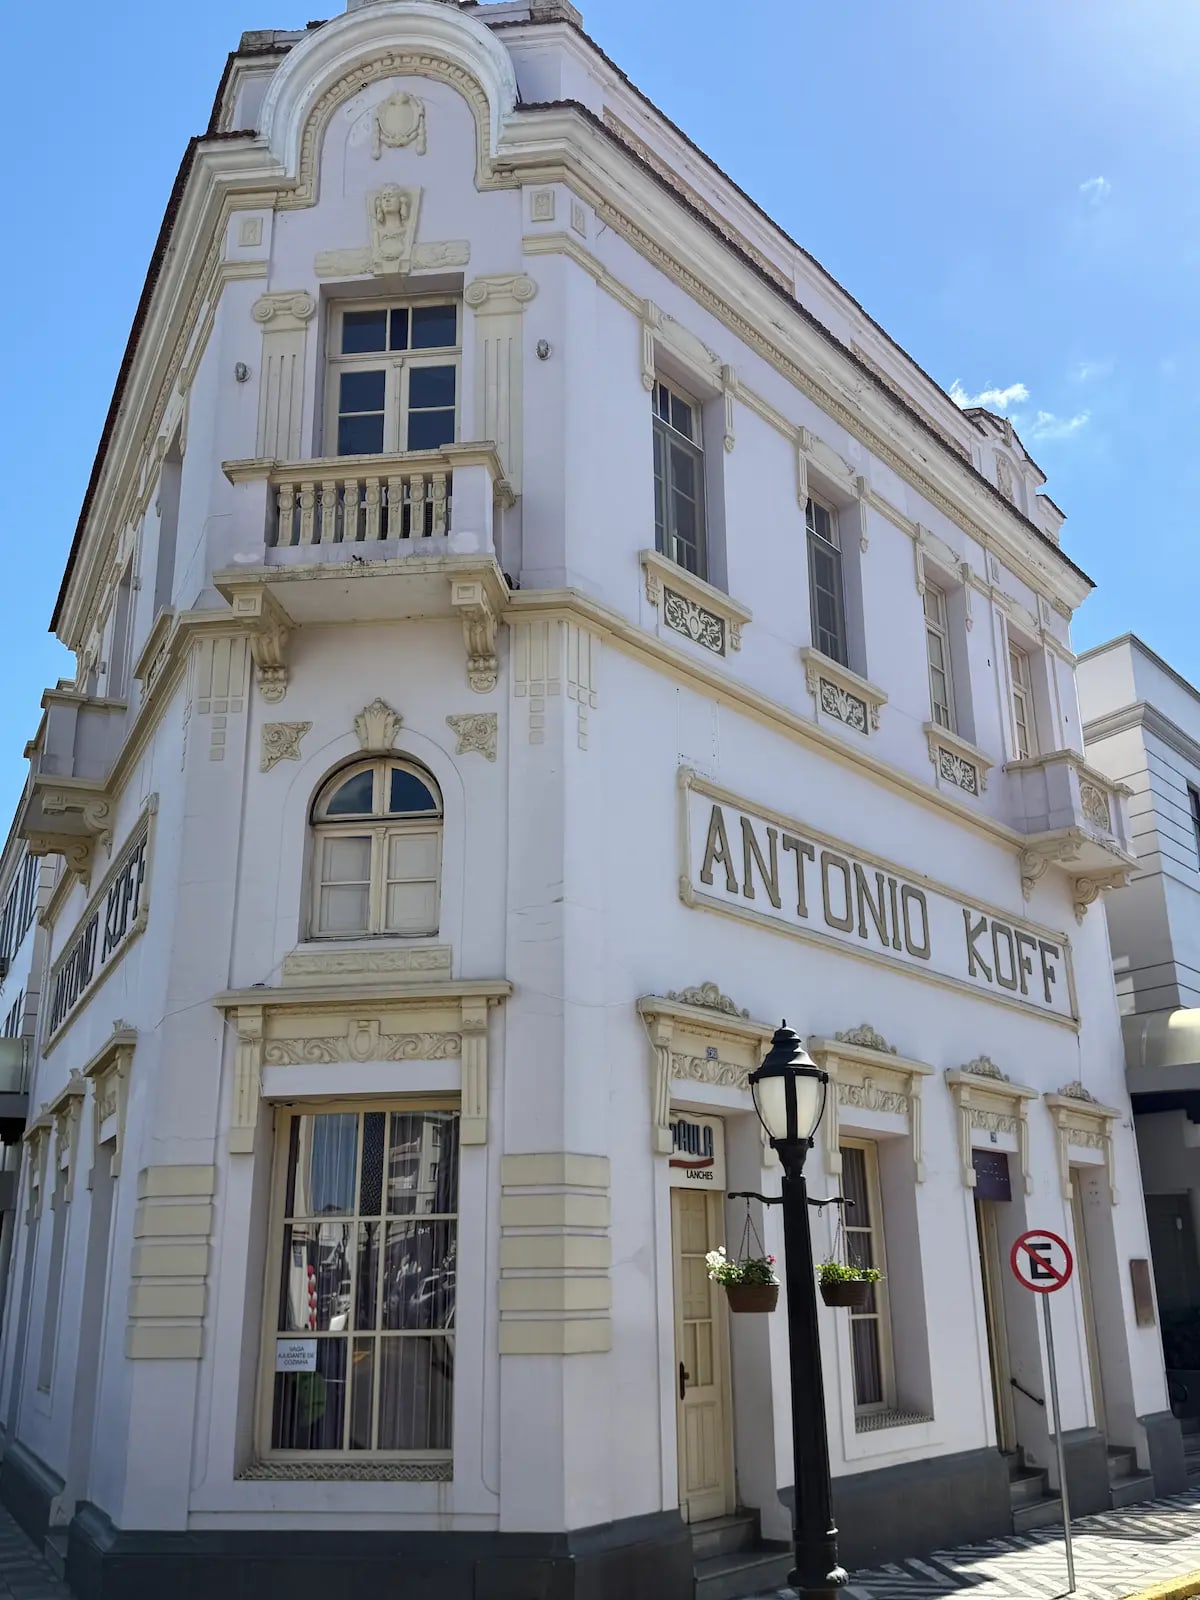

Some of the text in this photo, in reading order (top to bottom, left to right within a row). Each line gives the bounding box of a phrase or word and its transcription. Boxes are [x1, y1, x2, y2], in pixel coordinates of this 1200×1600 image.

[101, 832, 147, 963] KOFF
[700, 804, 1060, 1004] ANTONIO KOFF
[686, 1169, 714, 1180] LANCHES
[1028, 1243, 1055, 1280] E
